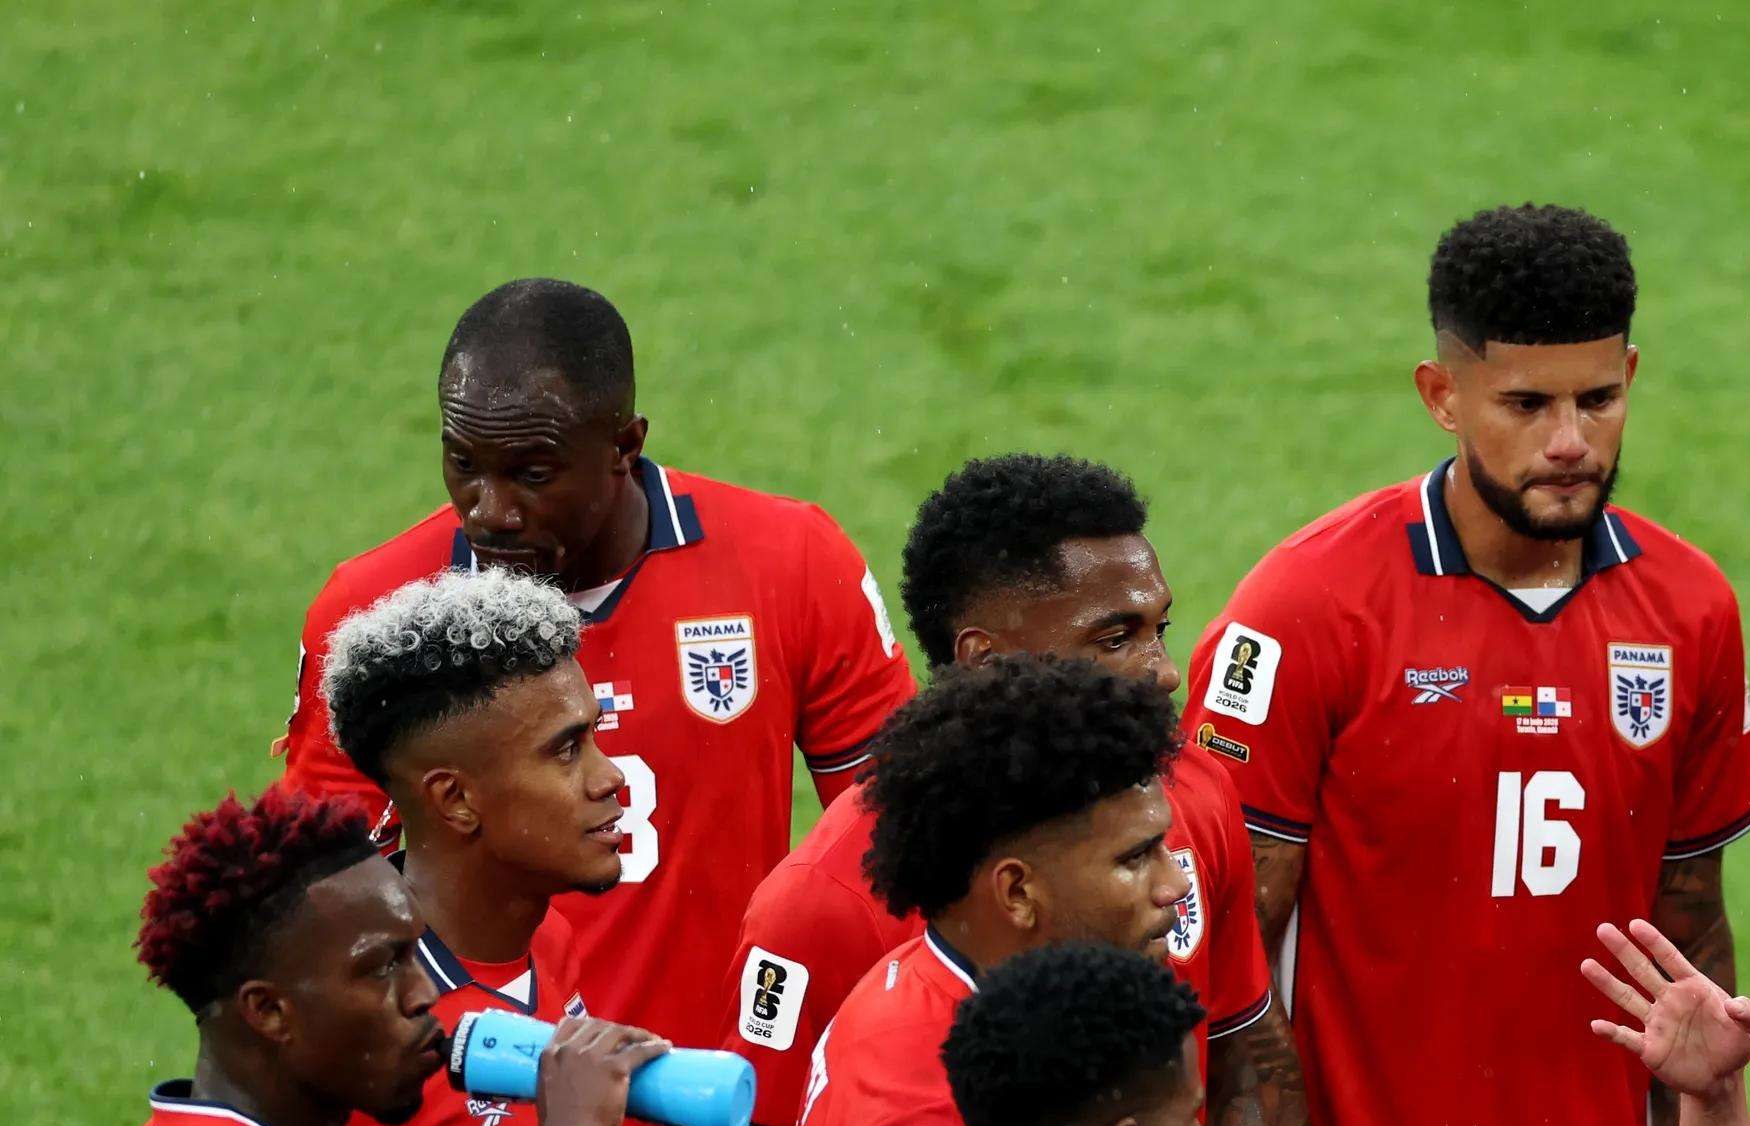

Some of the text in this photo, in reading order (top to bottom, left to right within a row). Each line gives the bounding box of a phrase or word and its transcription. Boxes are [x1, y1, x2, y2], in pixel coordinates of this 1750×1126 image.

[683, 622, 746, 638] PANAMÁ
[1613, 650, 1665, 664] PANAMÁ
[1404, 666, 1469, 685] Reebok
[1215, 695, 1248, 713] 2026
[1212, 737, 1246, 754] DEBUT
[1491, 770, 1586, 897] 16
